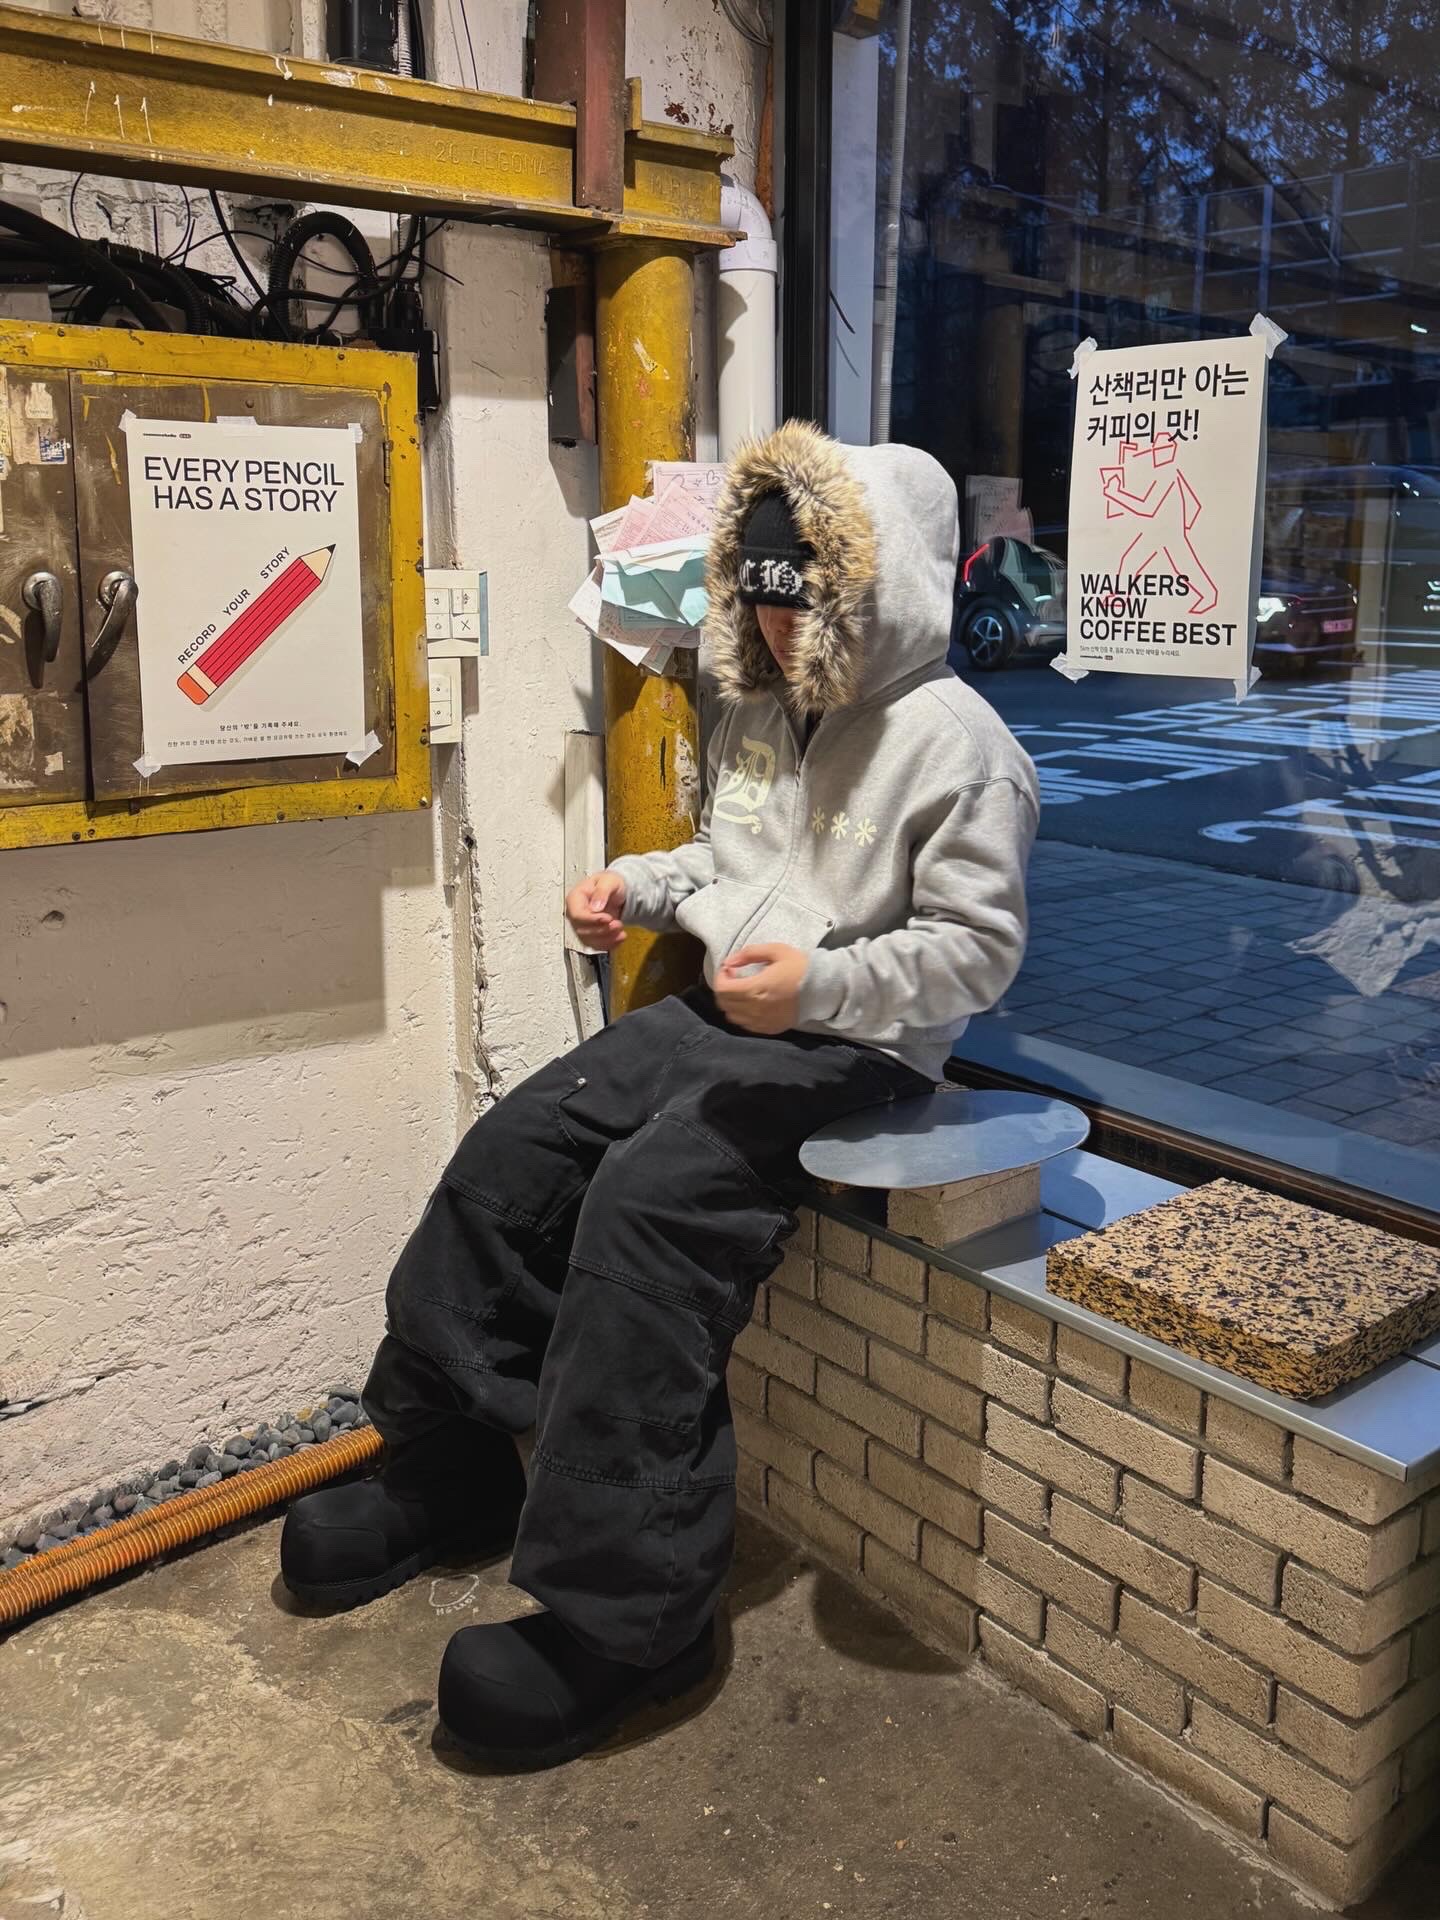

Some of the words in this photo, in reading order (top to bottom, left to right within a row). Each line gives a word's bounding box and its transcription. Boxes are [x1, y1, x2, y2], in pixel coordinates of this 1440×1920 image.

[1089, 367, 1187, 406] 산책러만
[1195, 363, 1249, 397] 아는
[1087, 411, 1156, 446] 커피의
[1167, 409, 1199, 442] 맛!
[144, 456, 240, 483] EVERY
[245, 460, 345, 486] PENCIL
[154, 485, 213, 510] HAS
[219, 487, 240, 511] A
[244, 487, 338, 513] STORY
[1080, 573, 1190, 597] WALKERS
[177, 623, 217, 664] RECORD
[222, 588, 251, 616] YOUR
[260, 546, 290, 579] STORY
[1081, 596, 1148, 619] KNOW
[1080, 619, 1166, 643] COFFEE
[1172, 622, 1237, 646] BEST
